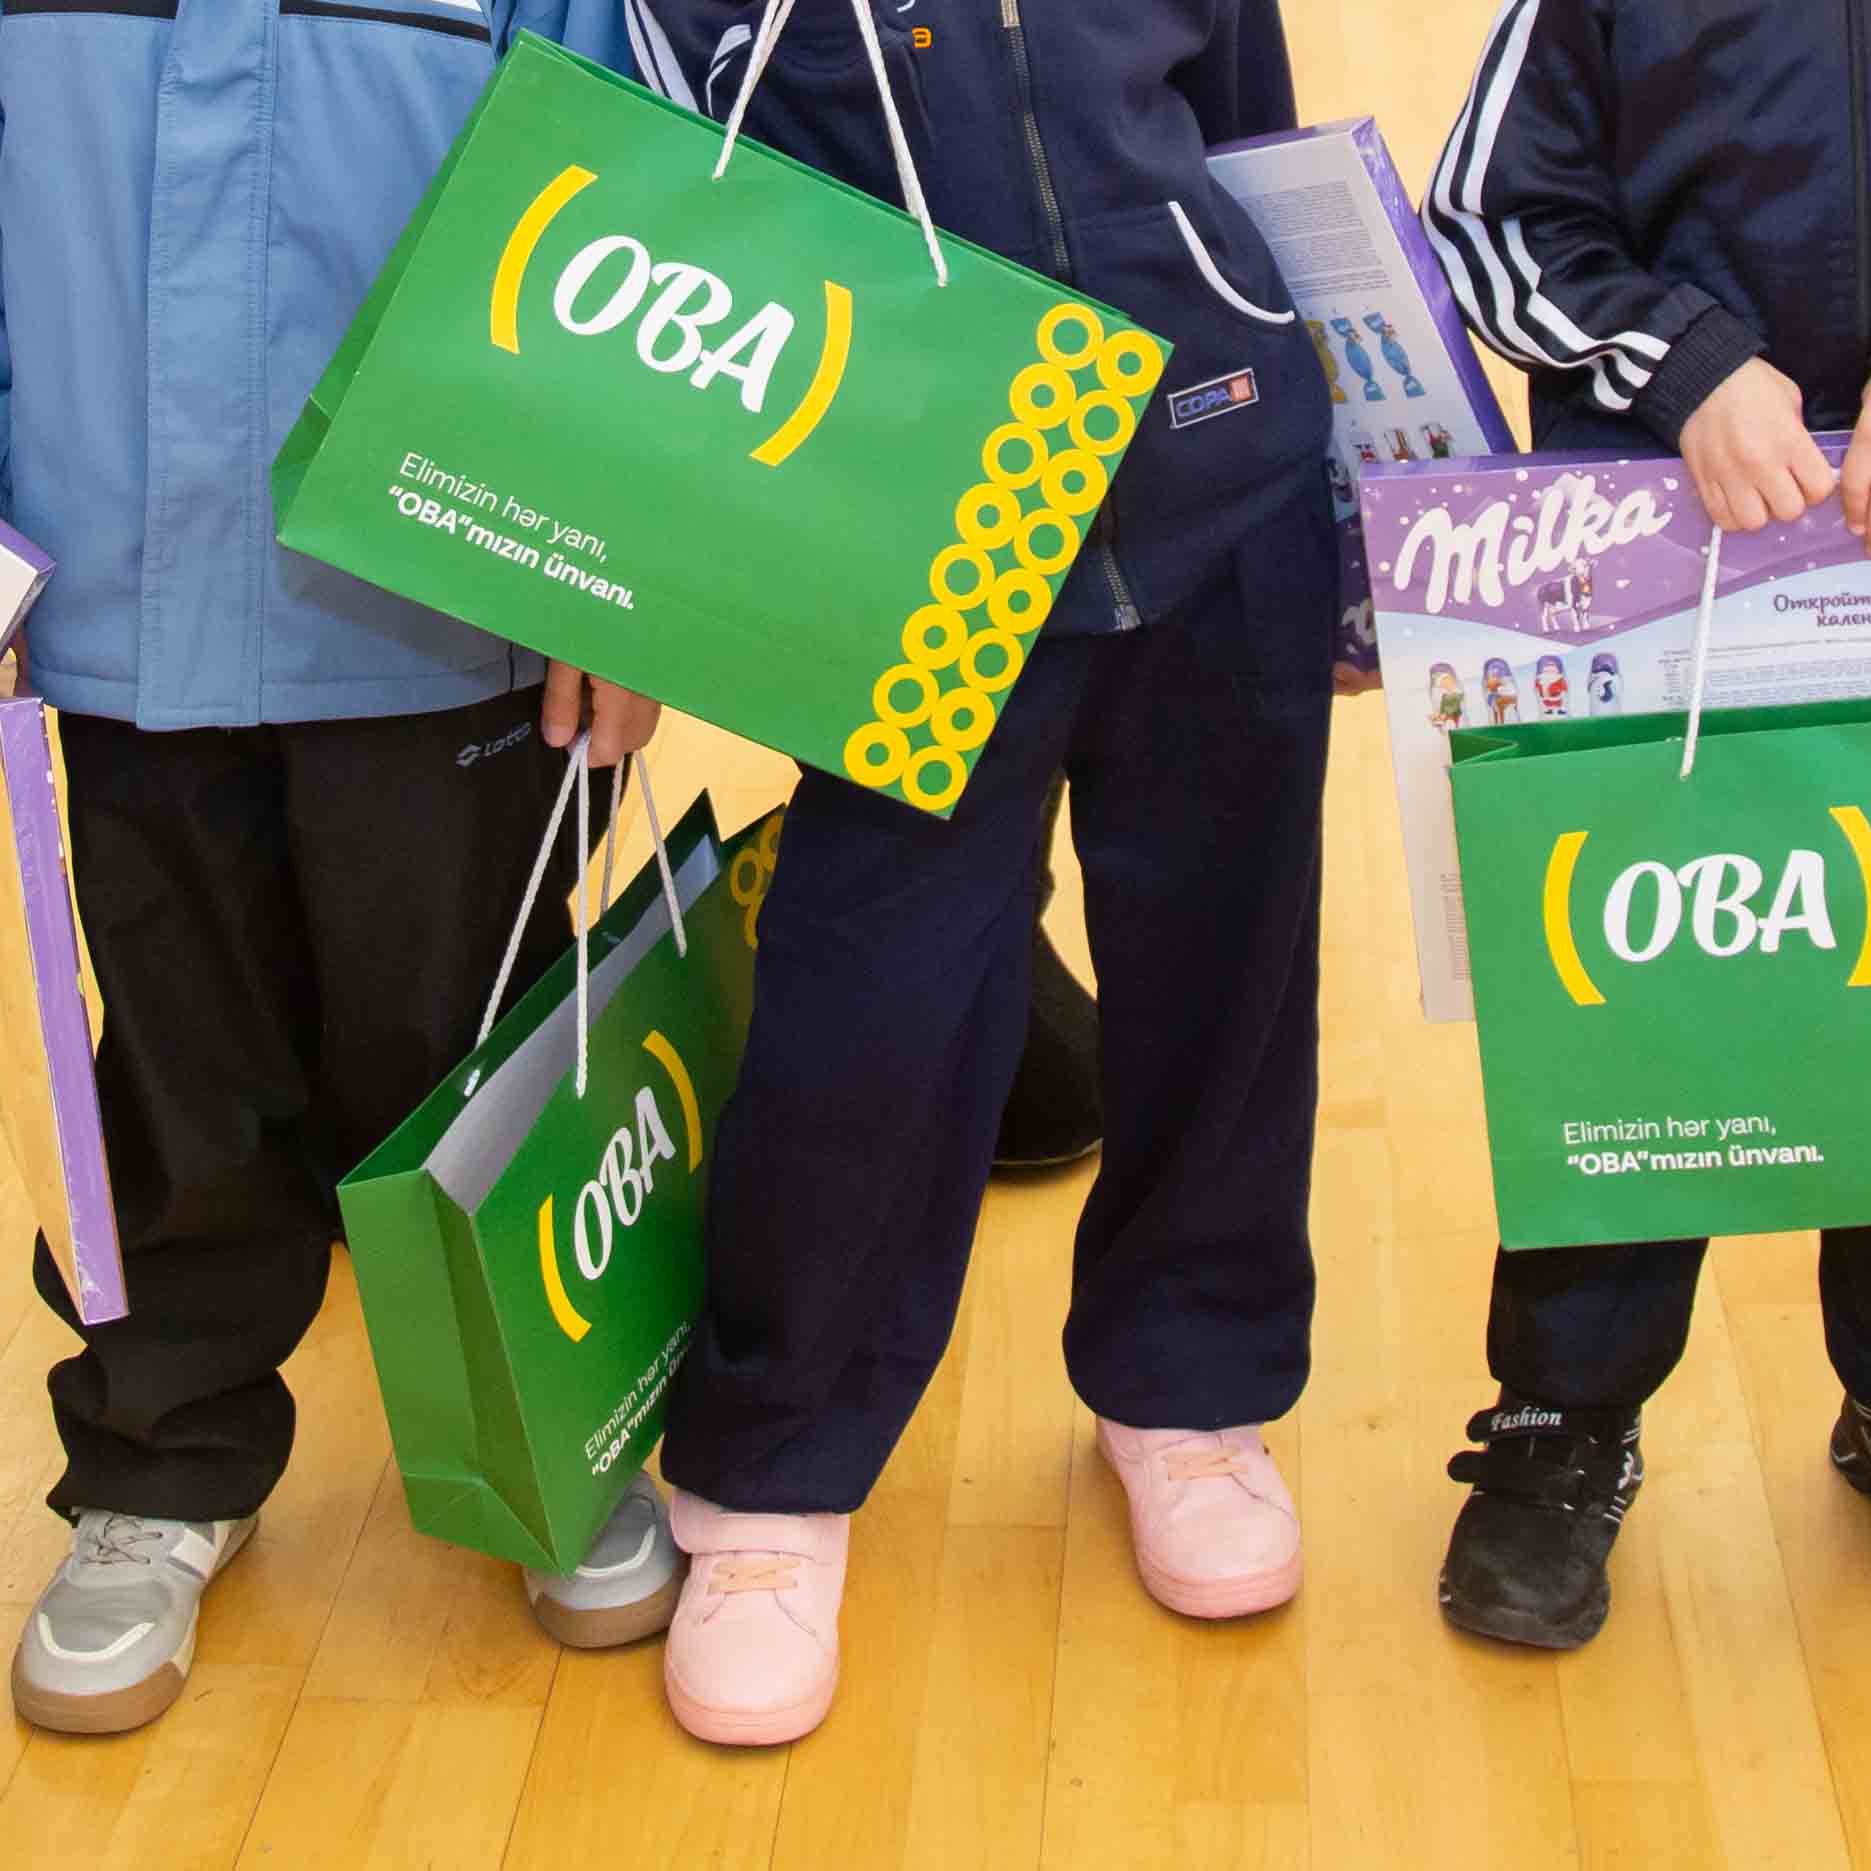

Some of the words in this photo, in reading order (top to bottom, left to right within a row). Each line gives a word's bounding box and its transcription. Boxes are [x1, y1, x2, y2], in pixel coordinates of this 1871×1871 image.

[399, 451, 499, 513] Elimizin
[501, 495, 550, 532] hər
[546, 520, 608, 563] yanı,
[1393, 471, 1673, 614] Milka
[543, 553, 635, 611] ünvanı.
[1562, 1118, 1661, 1145] Elimizin
[1666, 1115, 1710, 1138] hər
[1715, 1114, 1777, 1141] yanı,
[1728, 1144, 1825, 1166] ünvanı.
[584, 1390, 638, 1461] Elimizin
[1490, 1405, 1563, 1432] Fashion
